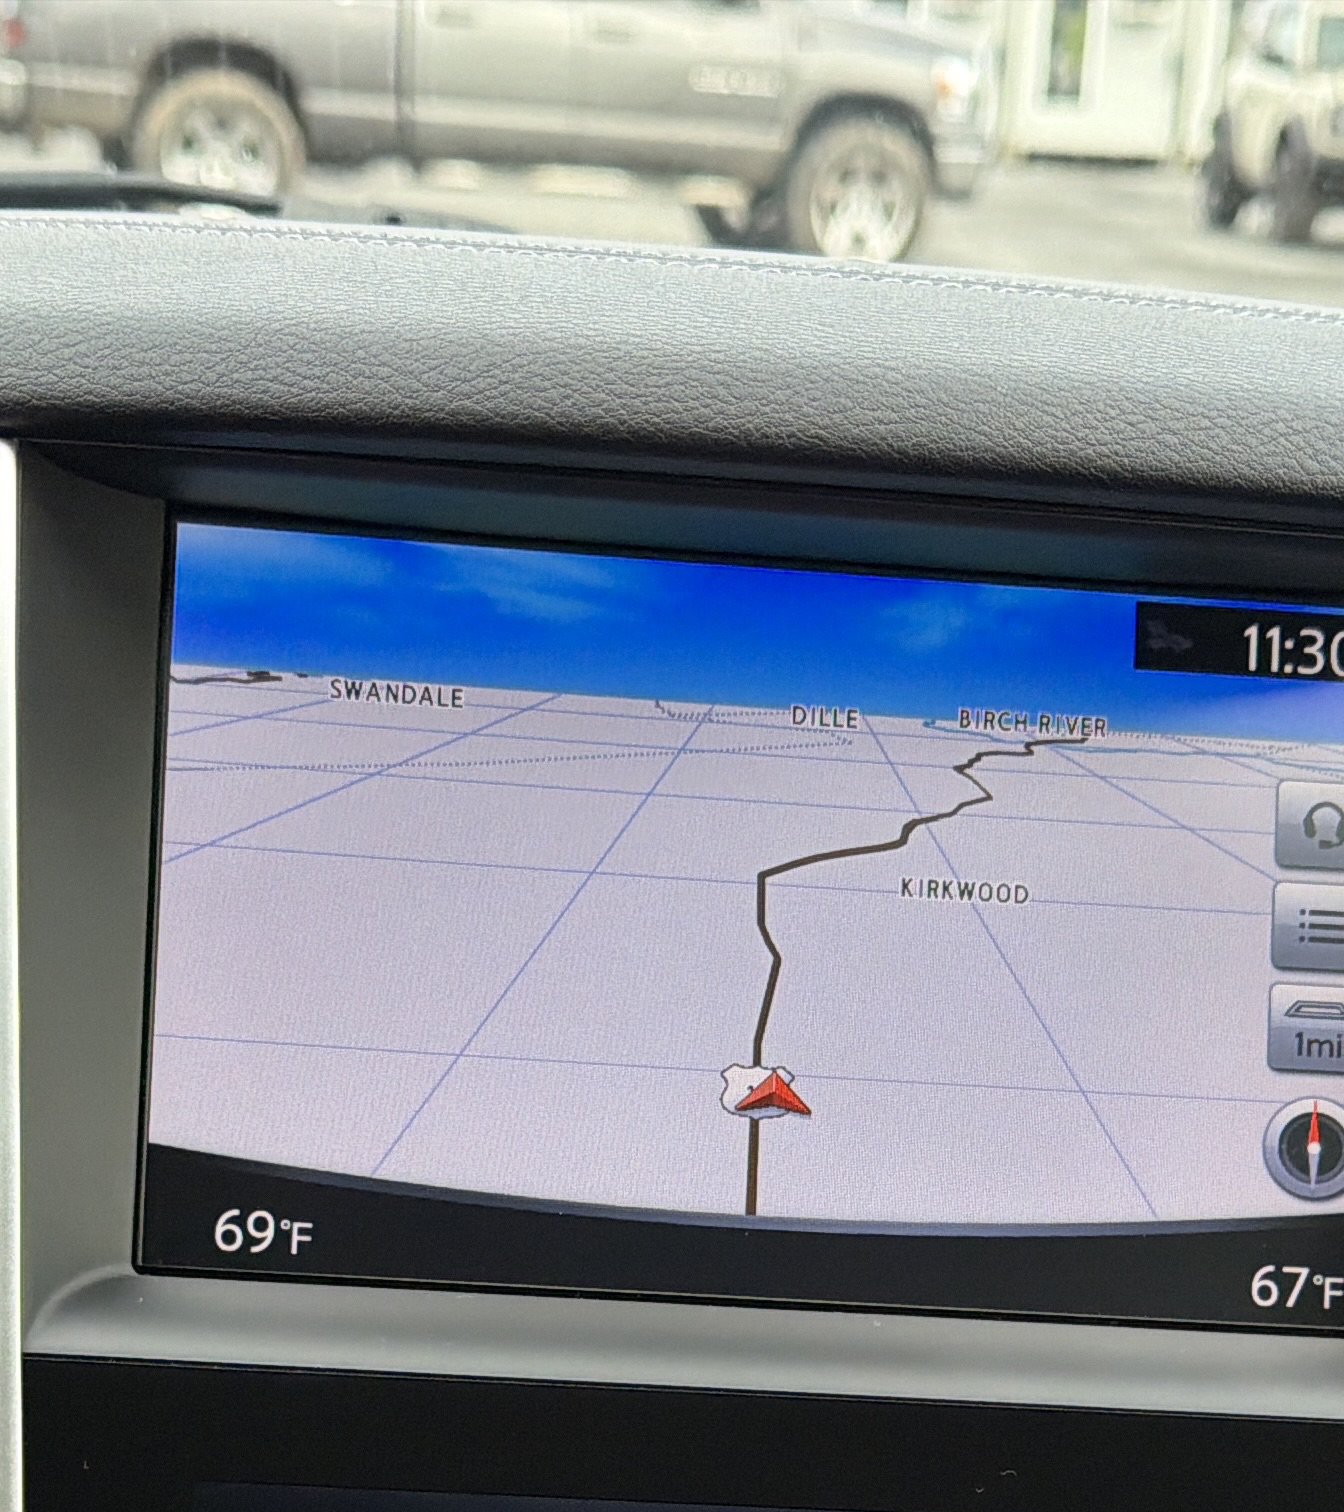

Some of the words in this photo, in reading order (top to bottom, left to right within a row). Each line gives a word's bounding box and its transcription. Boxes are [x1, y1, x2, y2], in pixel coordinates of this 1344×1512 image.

[330, 679, 465, 709] SWANDALE
[791, 703, 859, 731] DILLE
[958, 708, 1030, 735] BIRCH
[1037, 713, 1107, 740] RIVER
[900, 877, 1030, 905] KIRKWOOD
[1293, 1031, 1342, 1060] 1mi
